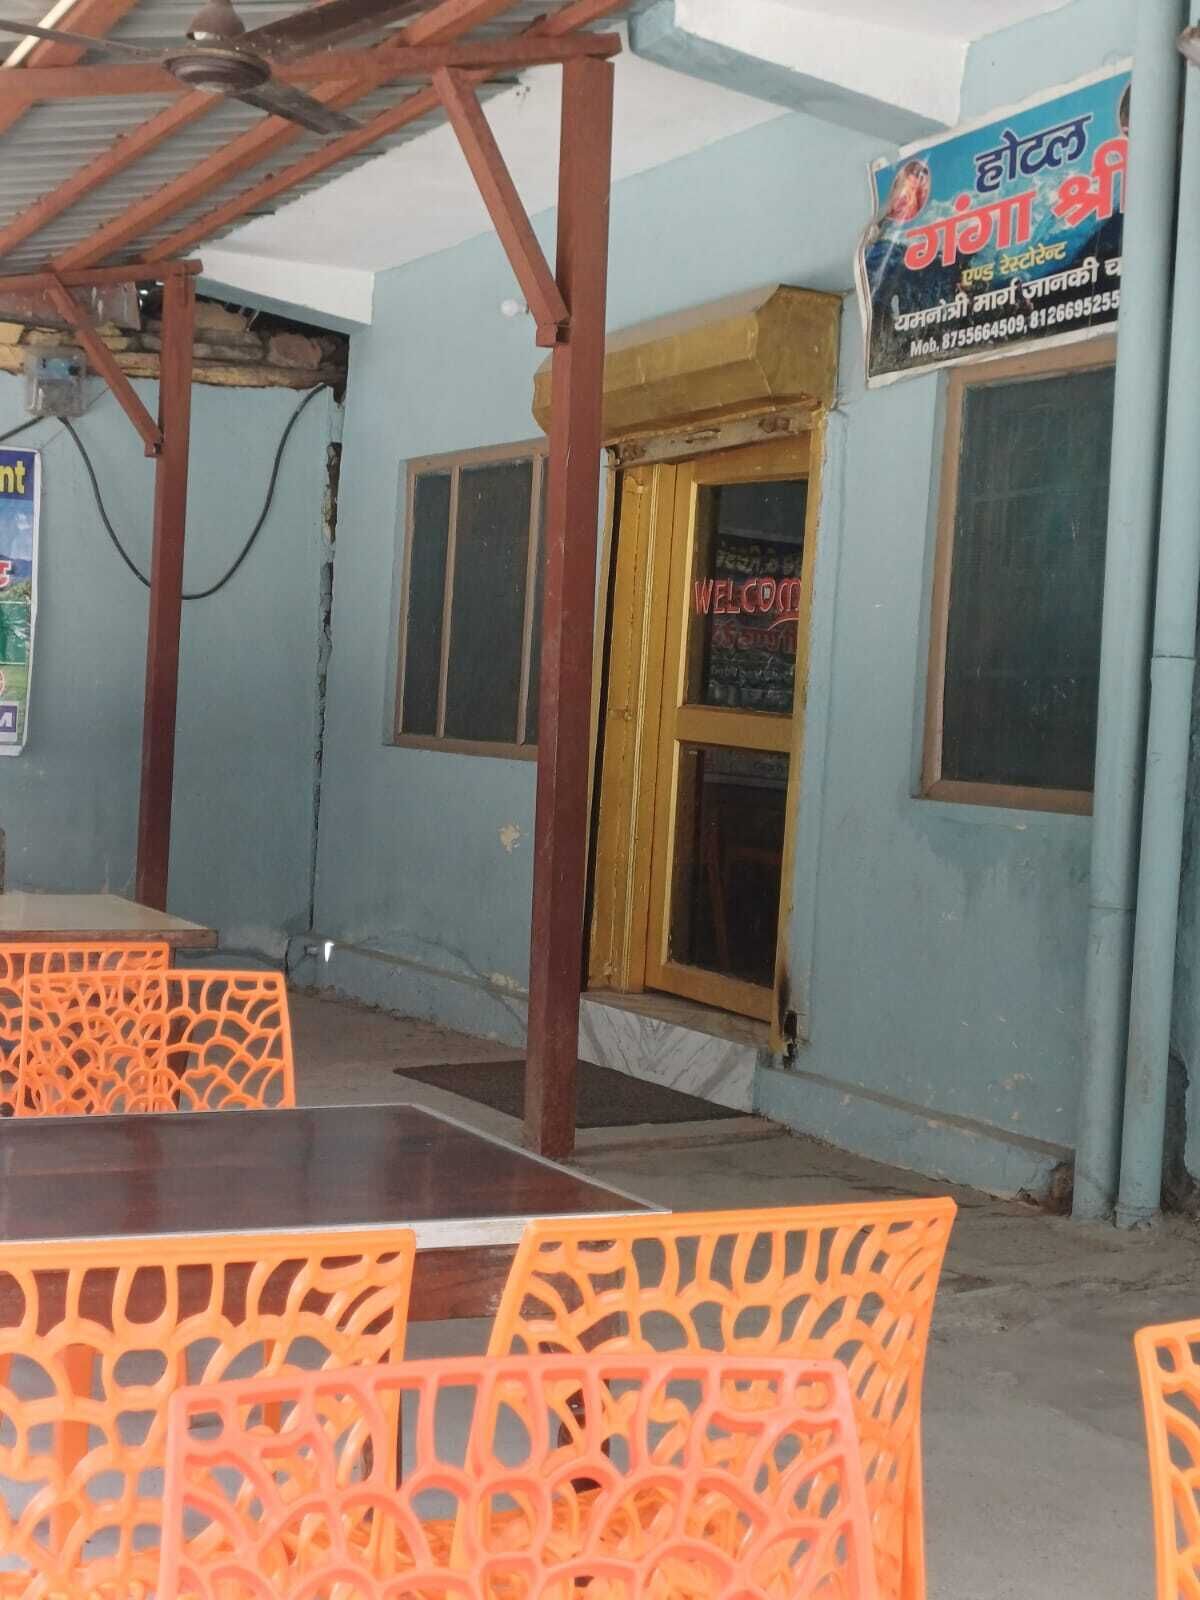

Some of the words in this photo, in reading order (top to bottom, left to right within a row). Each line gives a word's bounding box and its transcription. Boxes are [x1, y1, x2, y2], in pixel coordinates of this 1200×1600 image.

[975, 115, 1092, 193] होटल
[903, 192, 1037, 270] गंगा
[973, 277, 1019, 313] मार्ग
[1021, 256, 1099, 299] जानकी
[1030, 289, 1120, 329] 8126695255
